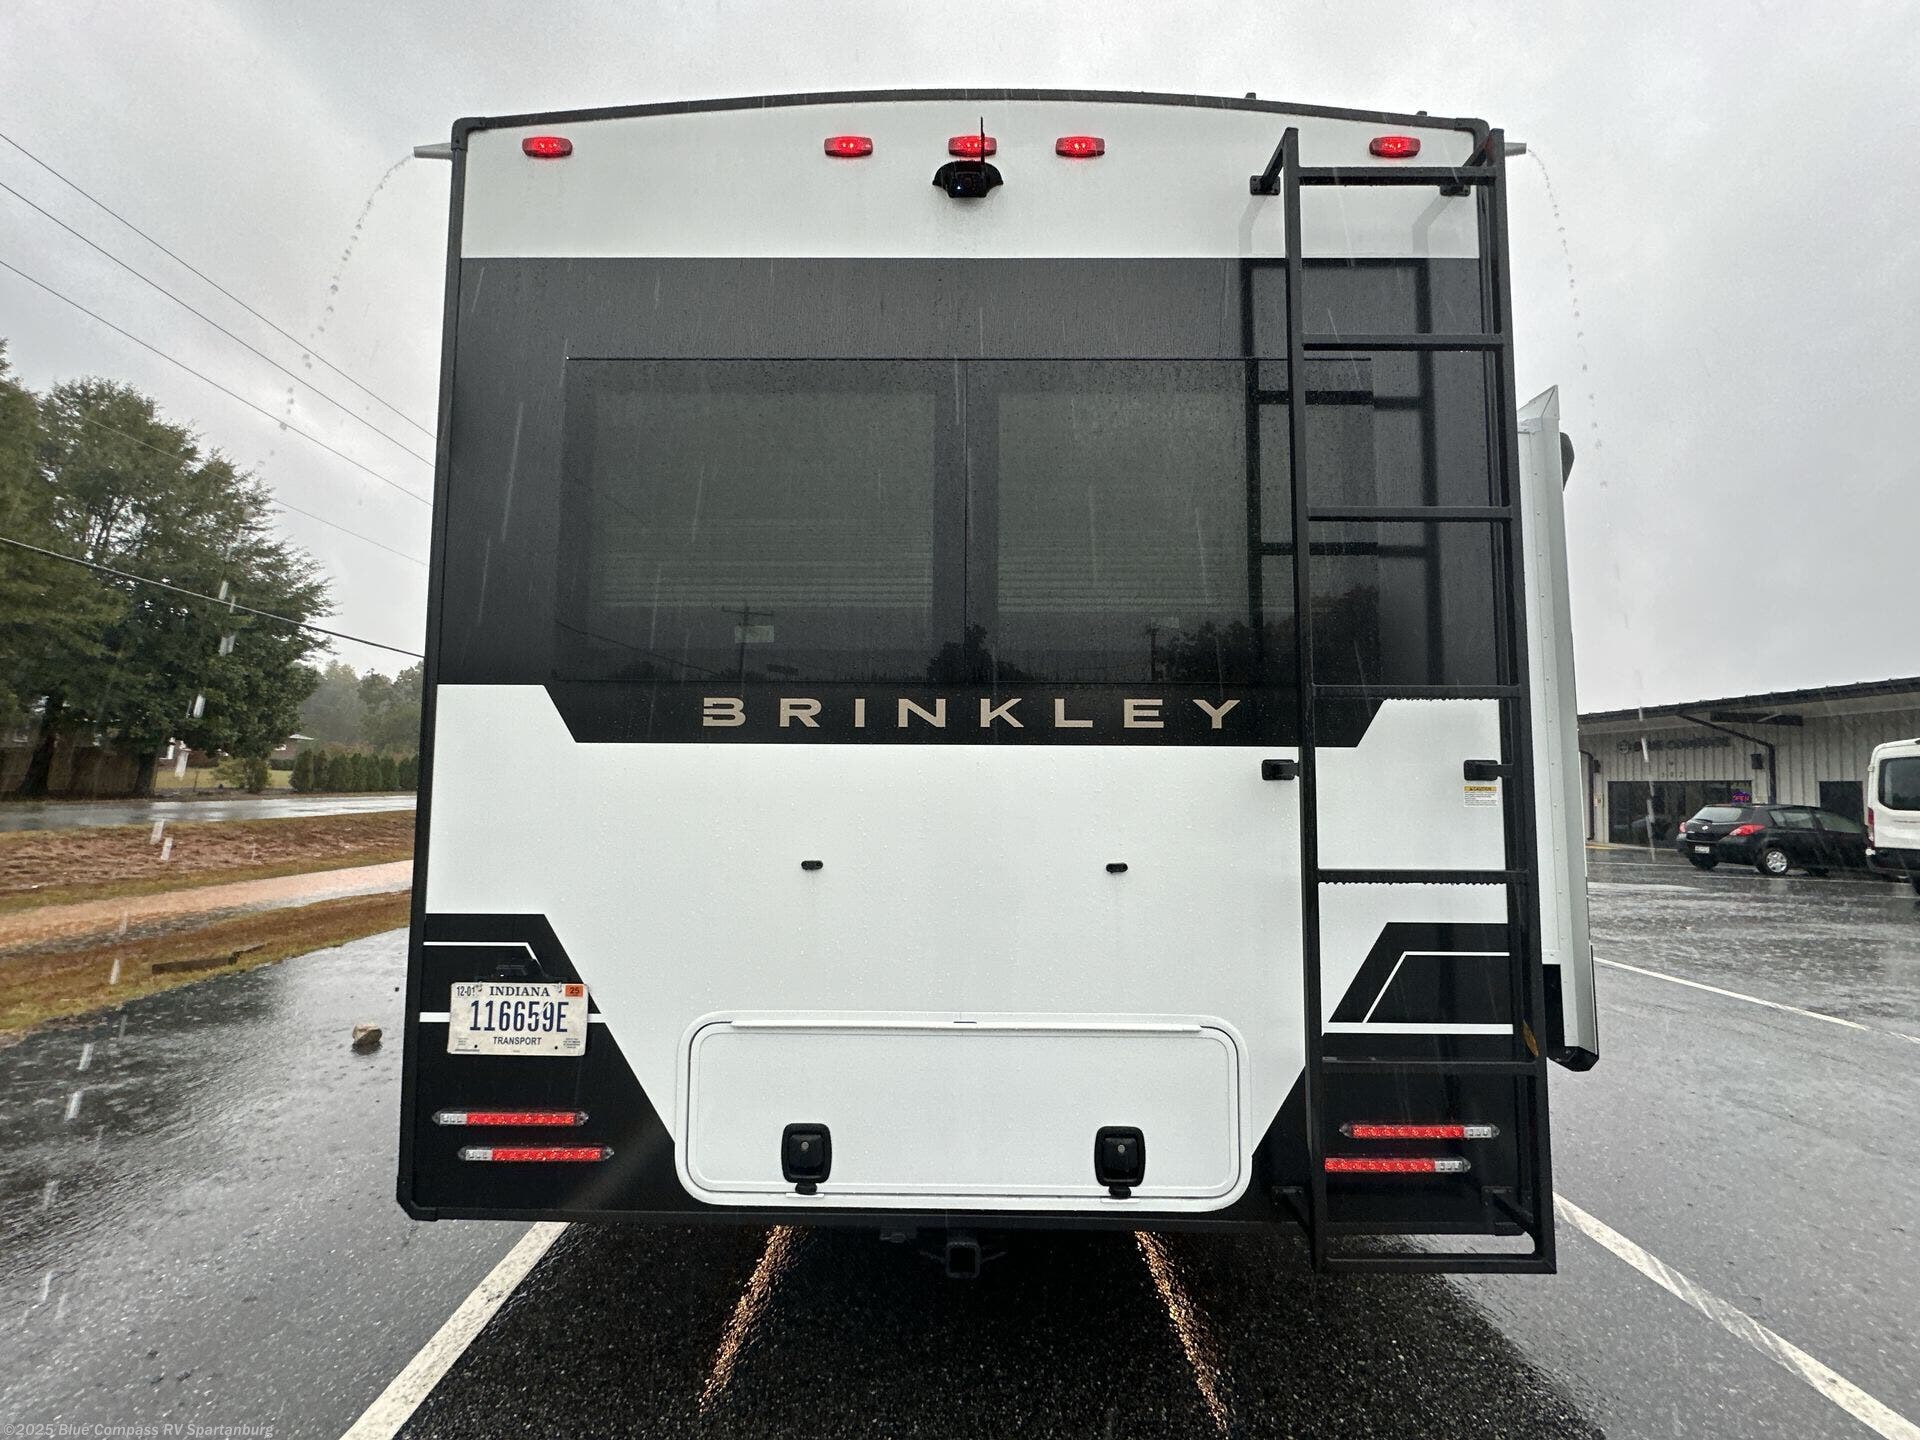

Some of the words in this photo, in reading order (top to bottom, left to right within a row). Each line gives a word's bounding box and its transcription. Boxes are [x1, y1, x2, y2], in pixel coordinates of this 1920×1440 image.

[703, 698, 1241, 730] BRINKLEY
[490, 986, 550, 997] INDIANA
[569, 987, 580, 995] 25
[469, 1000, 569, 1033] 116659E
[493, 1036, 542, 1046] TRANSPORT
